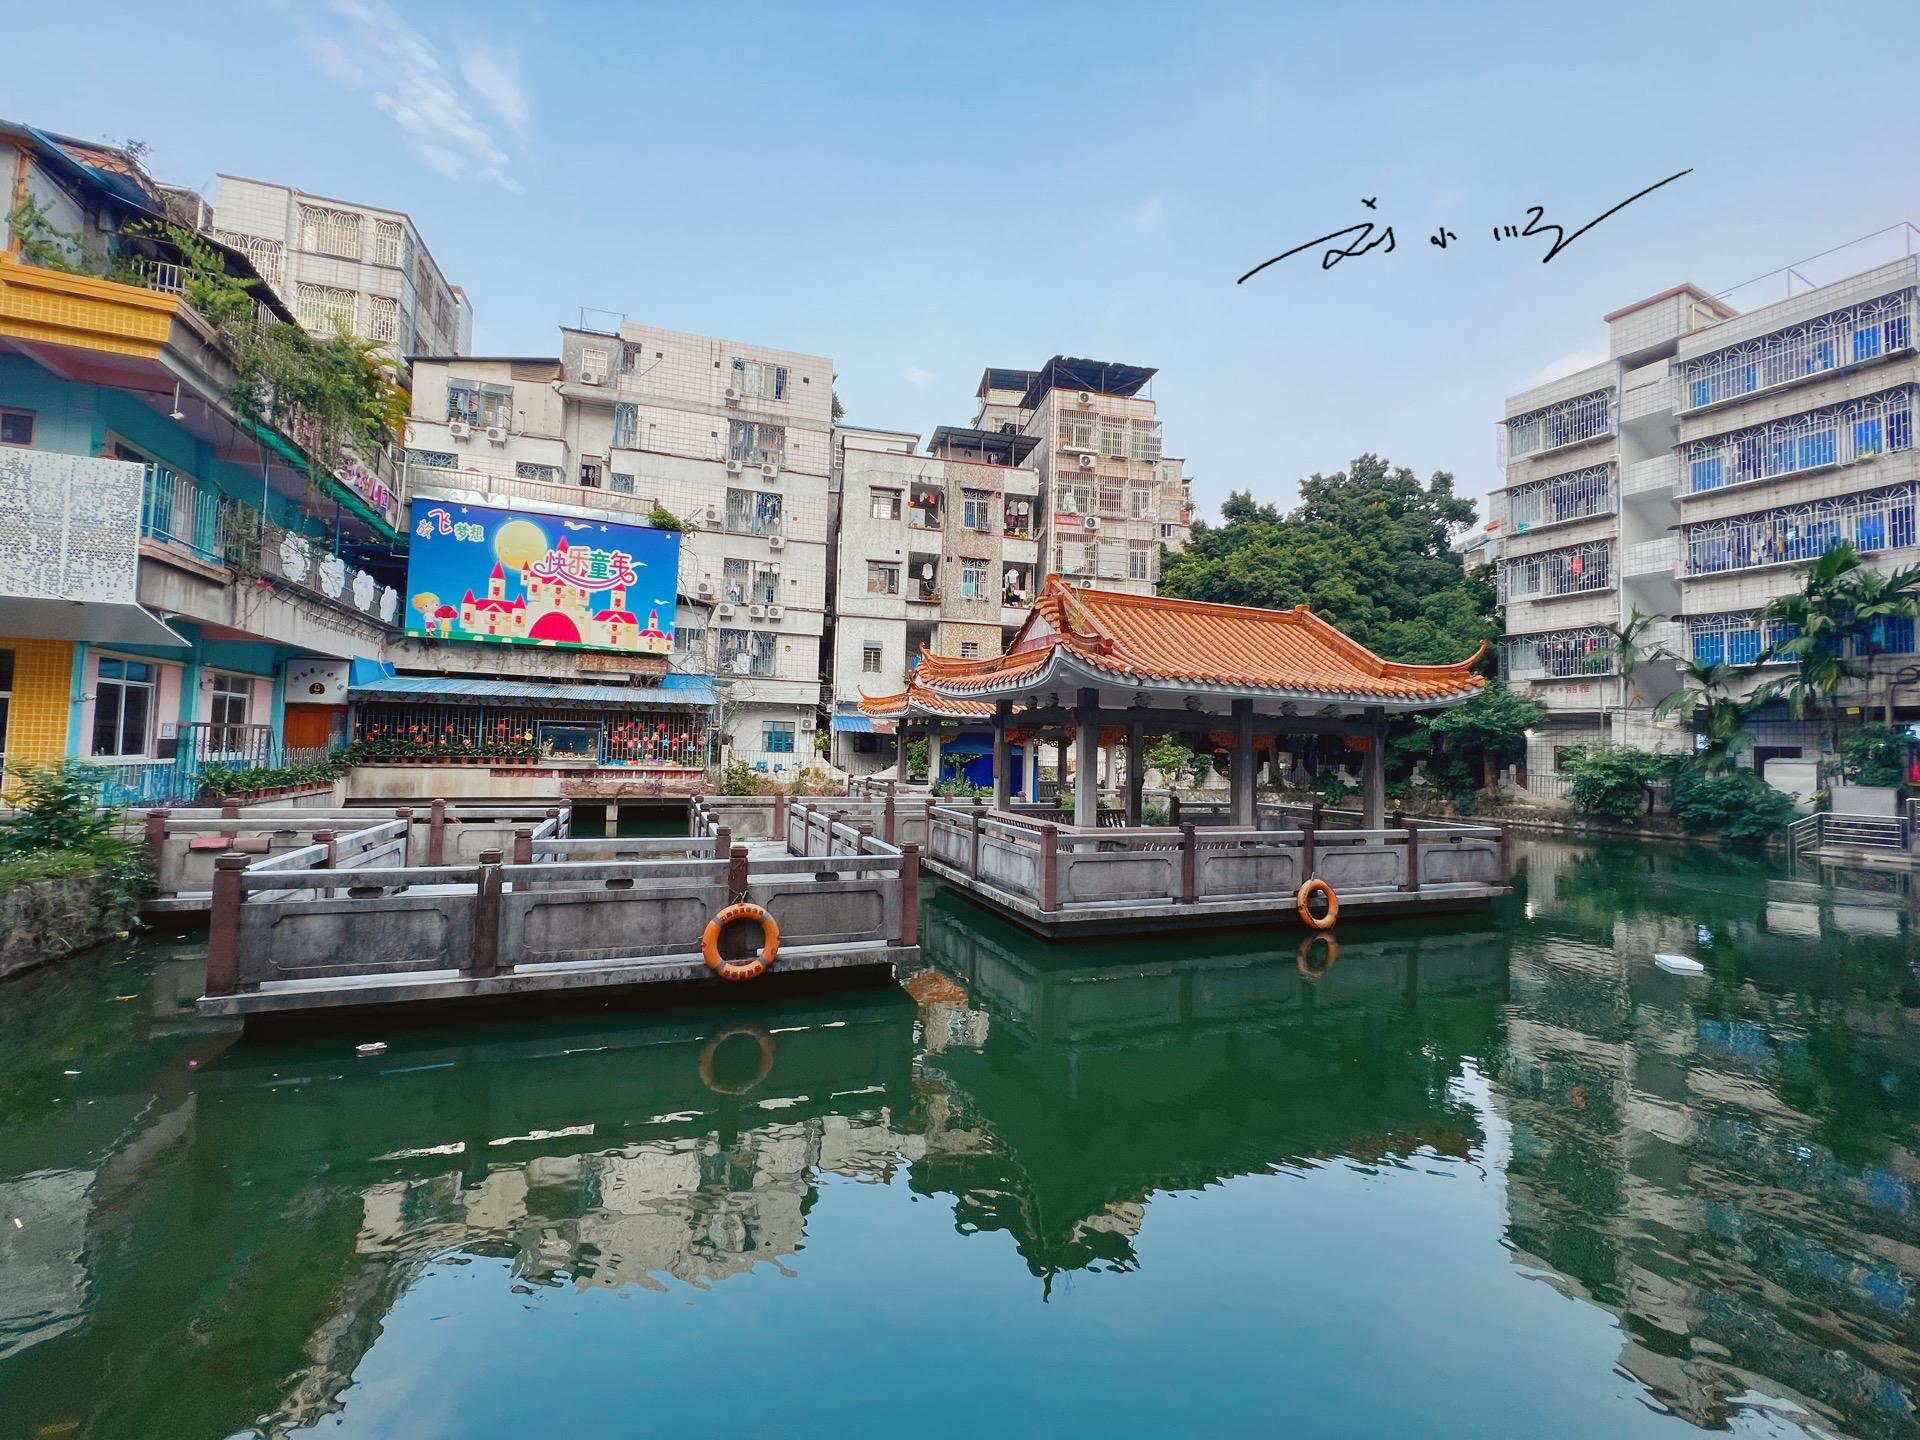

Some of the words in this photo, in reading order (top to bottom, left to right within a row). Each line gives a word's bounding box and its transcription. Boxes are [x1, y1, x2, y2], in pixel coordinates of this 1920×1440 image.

[416, 508, 485, 542] 放飞梦想
[534, 548, 636, 587] 快乐童年
